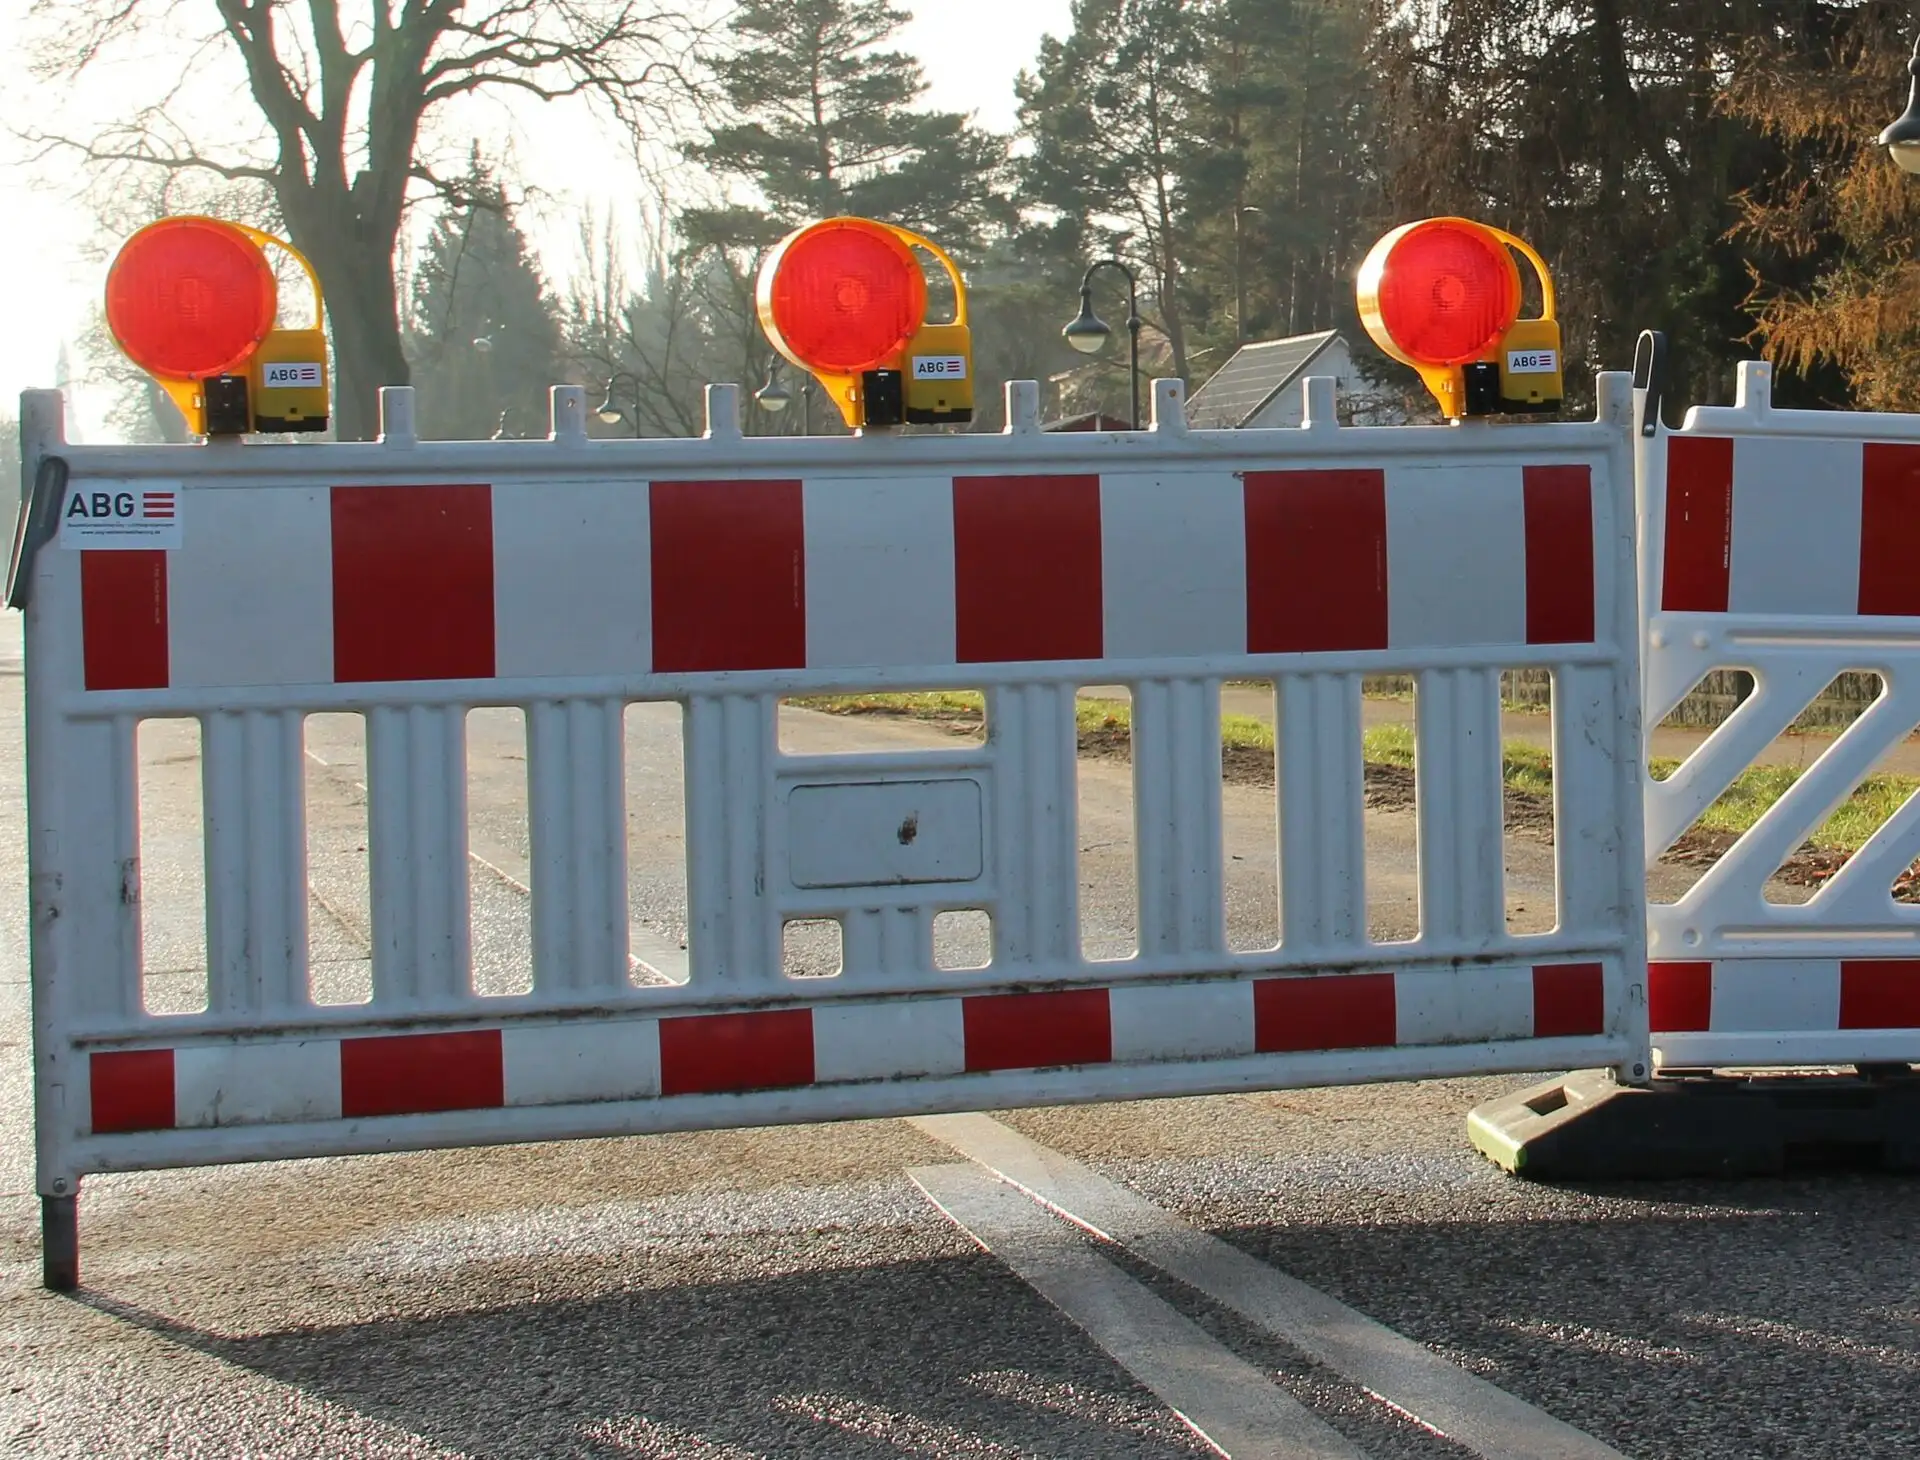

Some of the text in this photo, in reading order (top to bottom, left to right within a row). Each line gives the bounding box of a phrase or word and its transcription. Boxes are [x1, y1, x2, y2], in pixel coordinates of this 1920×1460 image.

[918, 362, 944, 374] ABG
[1513, 356, 1537, 368] ABG
[270, 368, 298, 381] ABG
[67, 492, 136, 518] ABG
